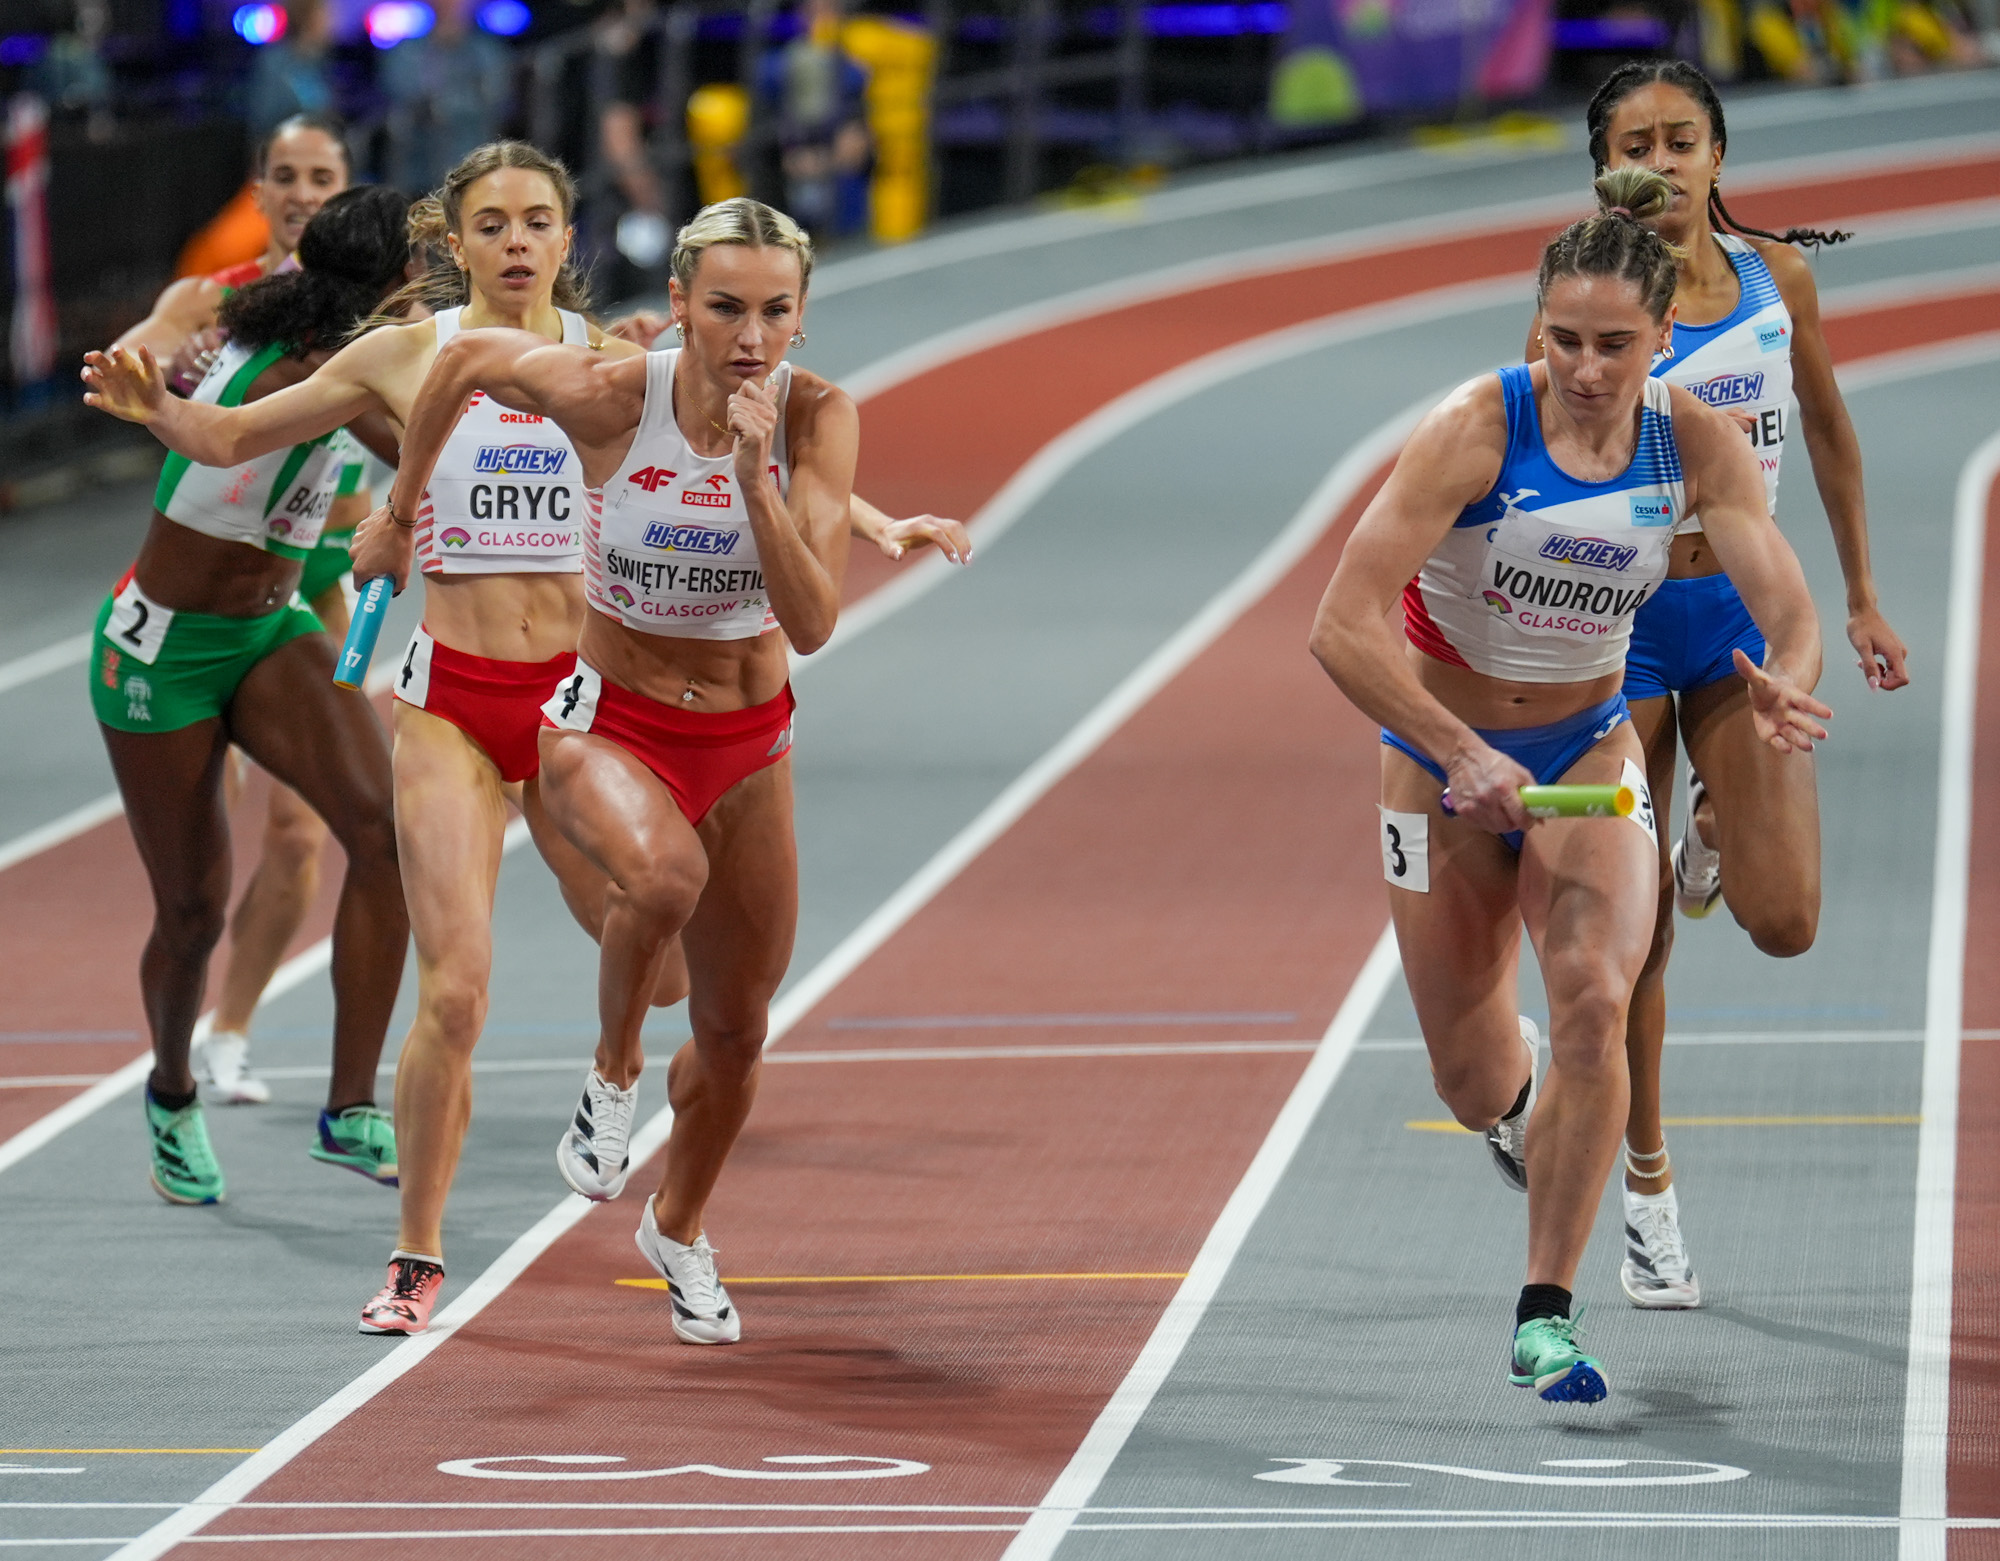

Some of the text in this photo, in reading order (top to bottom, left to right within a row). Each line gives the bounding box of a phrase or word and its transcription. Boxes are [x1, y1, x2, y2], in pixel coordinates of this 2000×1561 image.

[499, 413, 543, 424] ORLEN
[473, 445, 568, 475] HI-CHEW
[628, 466, 678, 493] 4F
[469, 484, 571, 522] GRYC
[684, 493, 729, 506] ORLEN
[1634, 504, 1661, 515] ČESKÁ
[478, 531, 571, 547] GLASGOW
[641, 520, 740, 555] HI-CHEW
[1539, 533, 1638, 572] HI-CHEW
[1493, 560, 1651, 617] VONDROVÁ
[641, 600, 738, 617] GLASGOW
[120, 599, 149, 648] 2
[345, 646, 363, 668] 4
[1387, 823, 1407, 877] 3
[436, 1454, 933, 1481] 3
[1252, 1457, 1752, 1487] 2
